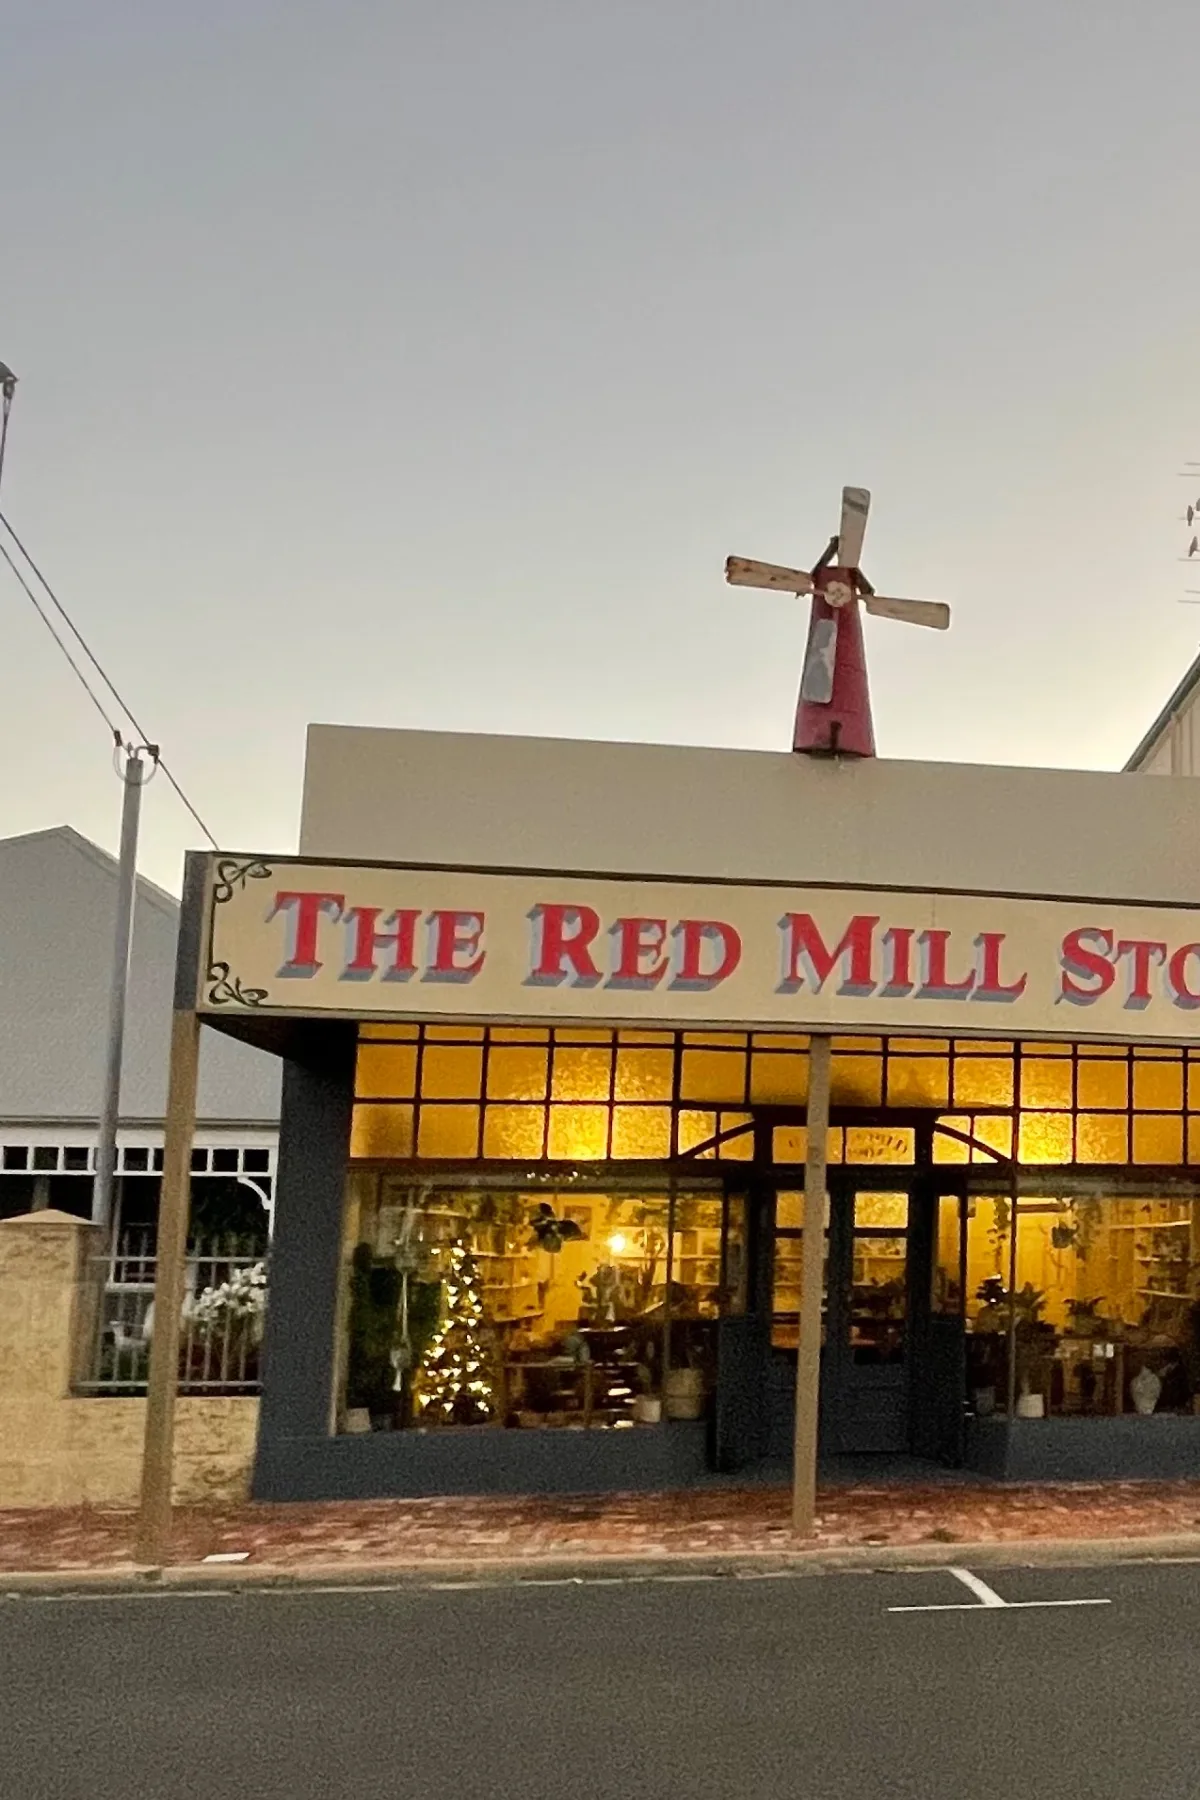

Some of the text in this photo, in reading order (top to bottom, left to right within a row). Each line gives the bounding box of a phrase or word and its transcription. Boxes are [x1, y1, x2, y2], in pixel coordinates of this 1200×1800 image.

[266, 891, 487, 984] THE
[521, 903, 742, 991] RED
[776, 911, 1027, 1003] MILL
